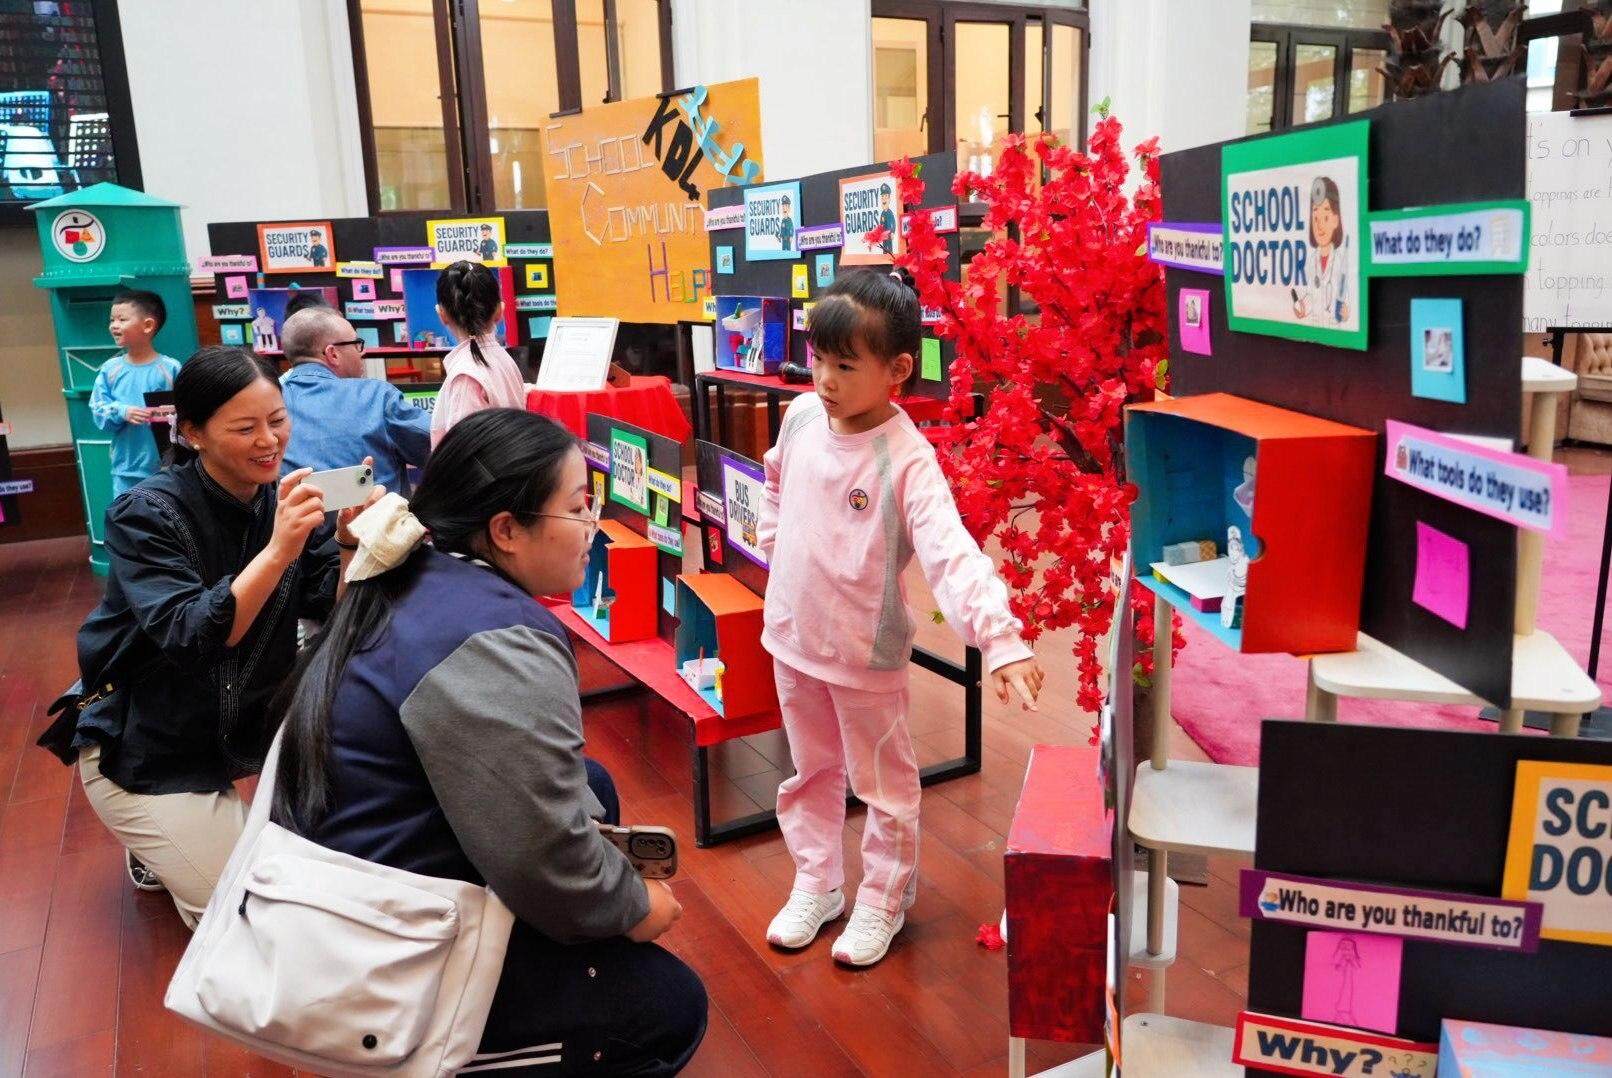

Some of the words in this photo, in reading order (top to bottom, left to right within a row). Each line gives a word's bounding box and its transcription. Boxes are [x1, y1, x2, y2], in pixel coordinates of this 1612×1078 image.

[545, 123, 655, 180] SCHOOL
[1561, 137, 1590, 158] on
[749, 199, 781, 216] SECURITY
[844, 188, 879, 211] SECURITY
[1231, 186, 1305, 233] SCHOOL
[436, 226, 479, 239] SECURITY
[749, 217, 781, 236] GUARDS
[845, 210, 880, 234] GUARDS
[1530, 221, 1580, 247] colors
[266, 232, 308, 245] SECURITY
[268, 244, 310, 258] GUARDS
[437, 239, 479, 252] GUARDS
[1154, 234, 1164, 253] Who
[1165, 239, 1173, 255] are
[1174, 241, 1184, 260] you
[1185, 238, 1210, 261] thankful
[1374, 230, 1402, 256] What
[1406, 229, 1421, 254] do
[1424, 228, 1453, 259] they
[1457, 225, 1481, 251] do?
[1231, 239, 1307, 286] DOCTOR
[1538, 256, 1604, 300] topping
[217, 307, 244, 317] Why?
[378, 305, 405, 314] Why?
[412, 397, 436, 410] BUS
[613, 441, 634, 466] SCHOOL
[735, 479, 749, 507] BUS
[1409, 448, 1435, 480] What
[1437, 457, 1464, 490] tools
[1468, 465, 1483, 495] do
[1487, 471, 1515, 512] they
[1518, 486, 1549, 517] use?
[729, 498, 758, 529] DRIVERS
[1543, 787, 1612, 839] SC
[1529, 844, 1612, 897] DO
[1279, 887, 1319, 916] Who
[1325, 903, 1356, 921] are
[1362, 906, 1395, 929] you
[1402, 904, 1486, 935] thankful
[1491, 915, 1523, 939] to?
[1256, 1030, 1383, 1075] Why?
